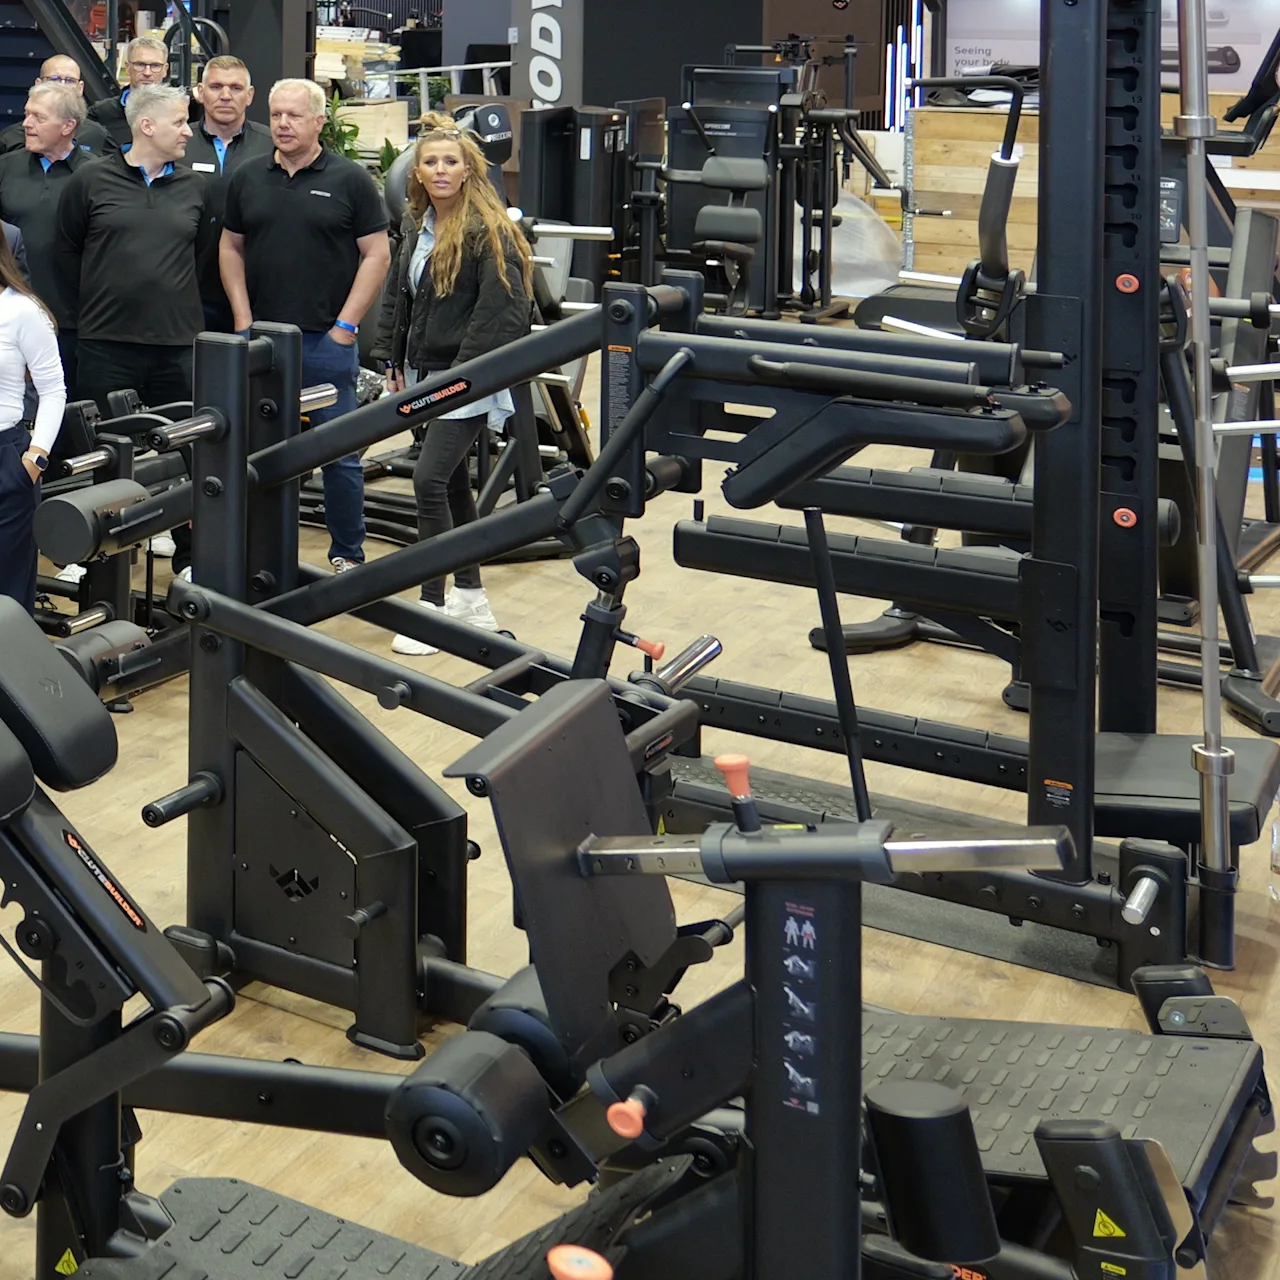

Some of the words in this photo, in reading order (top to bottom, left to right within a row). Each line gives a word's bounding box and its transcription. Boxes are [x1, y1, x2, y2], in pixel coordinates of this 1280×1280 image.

[954, 46, 992, 56] Seeing
[954, 58, 979, 67] your
[411, 381, 468, 411] GLUTEBUILDER
